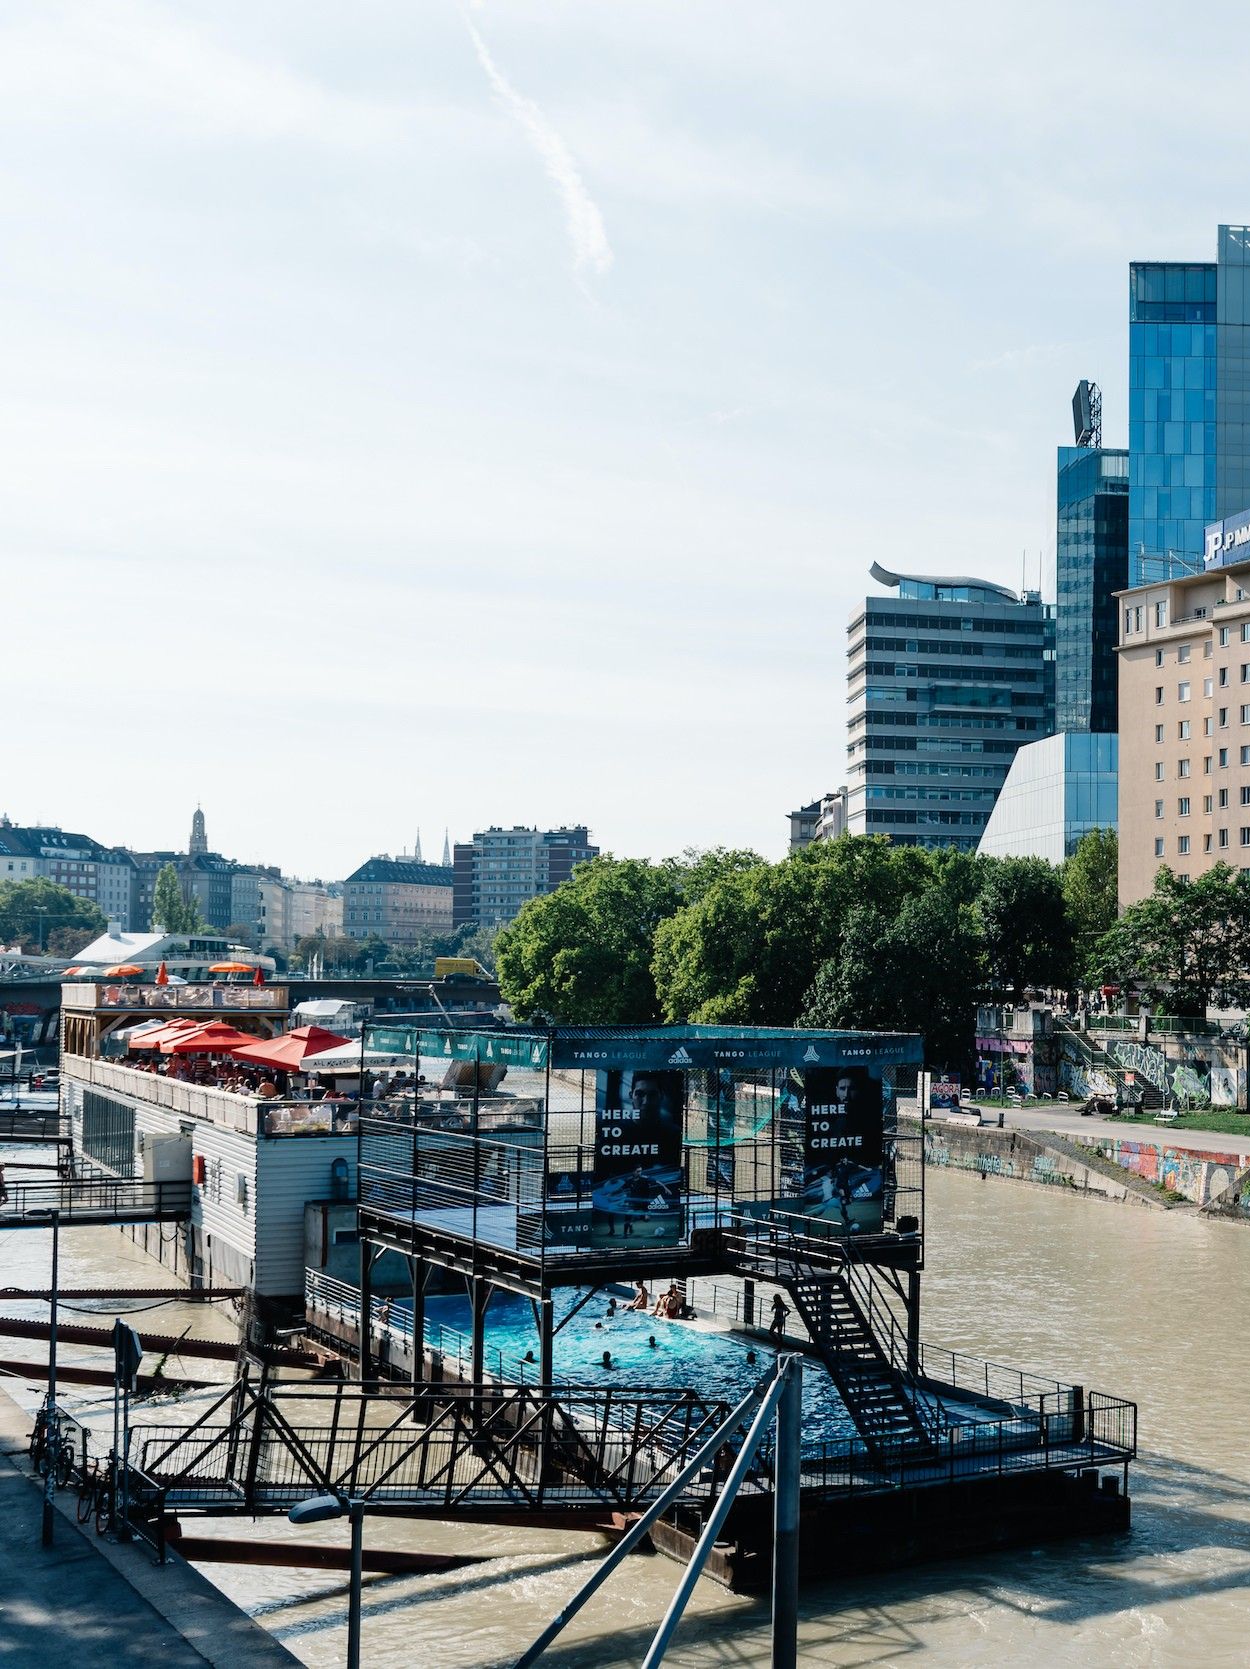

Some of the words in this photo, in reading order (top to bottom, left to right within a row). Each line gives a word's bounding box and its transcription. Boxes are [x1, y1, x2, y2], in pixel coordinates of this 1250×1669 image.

[574, 1051, 608, 1059] TANGO
[611, 1052, 648, 1060] LEAGUE
[714, 1050, 745, 1058] TANGO
[748, 1050, 782, 1058] LEAGUE
[874, 1047, 905, 1056] LEAGUE
[667, 1056, 693, 1064] adidas
[601, 1109, 641, 1120] HERE
[811, 1104, 846, 1115] HERE
[811, 1121, 830, 1132] TO
[601, 1127, 622, 1138] TO
[811, 1136, 863, 1149] CREATE
[601, 1144, 659, 1156] CREATE
